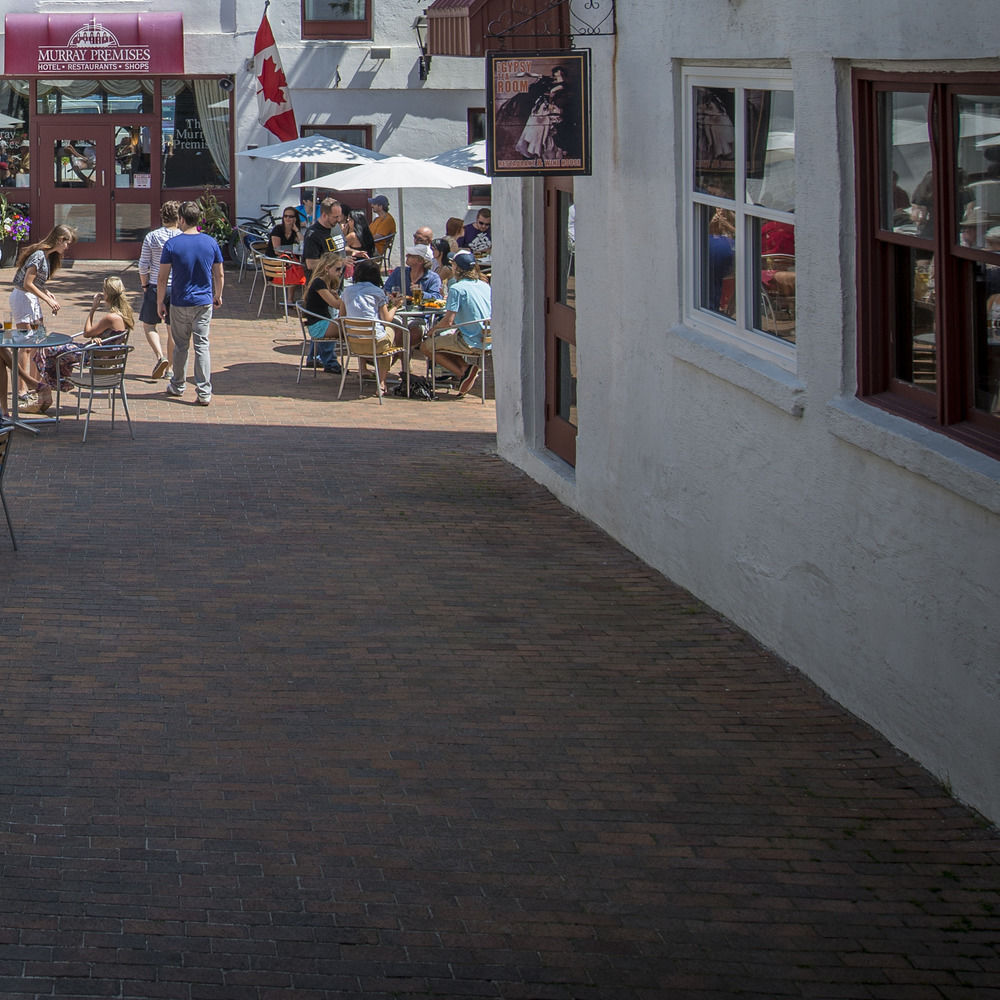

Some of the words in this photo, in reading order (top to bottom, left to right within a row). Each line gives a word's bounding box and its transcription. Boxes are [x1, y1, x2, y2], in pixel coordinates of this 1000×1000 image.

[38, 49, 87, 62] MURRAY
[91, 48, 151, 61] PREMISES
[38, 63, 61, 71] HOTEL
[501, 61, 532, 73] GYPSY
[497, 80, 529, 93] ROOM
[185, 118, 201, 129] Th
